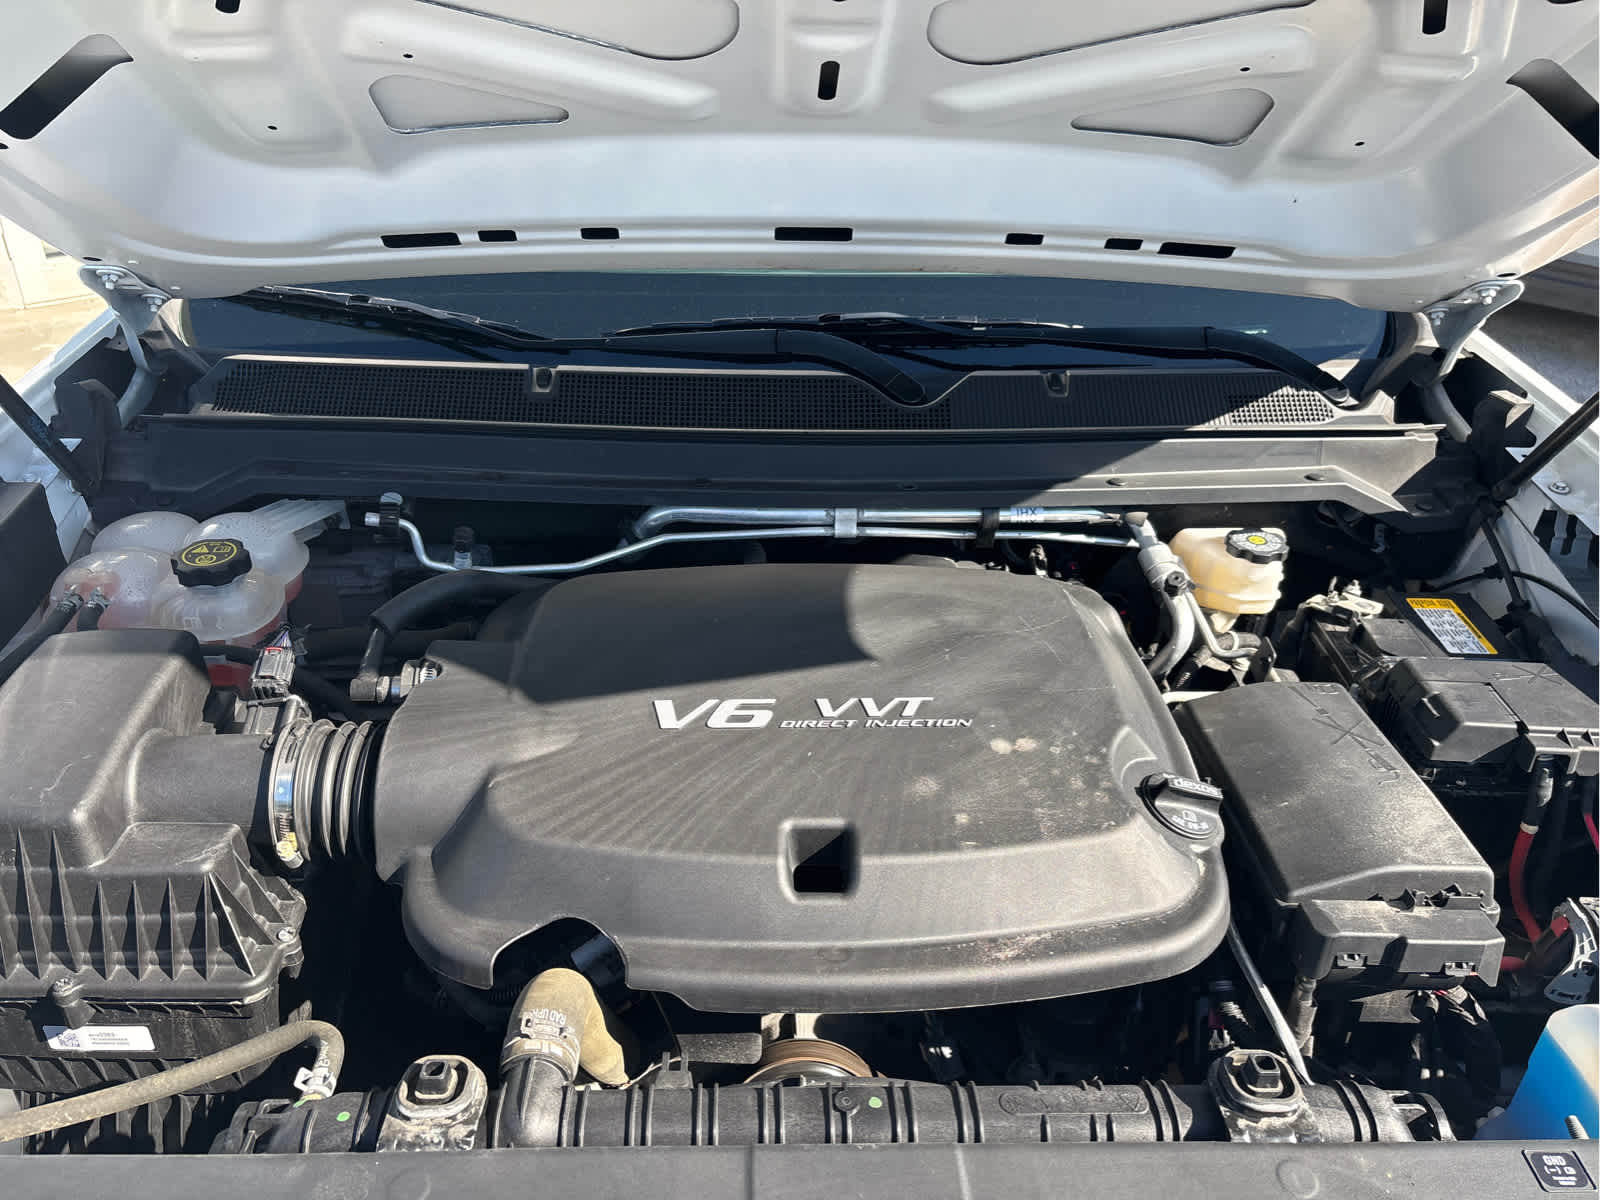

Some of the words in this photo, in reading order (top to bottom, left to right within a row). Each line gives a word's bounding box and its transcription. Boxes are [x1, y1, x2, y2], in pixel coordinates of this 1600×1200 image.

[653, 699, 776, 729] V6
[815, 697, 934, 717] VVT
[779, 719, 857, 728] DIRECT
[864, 719, 973, 728] INJECTION
